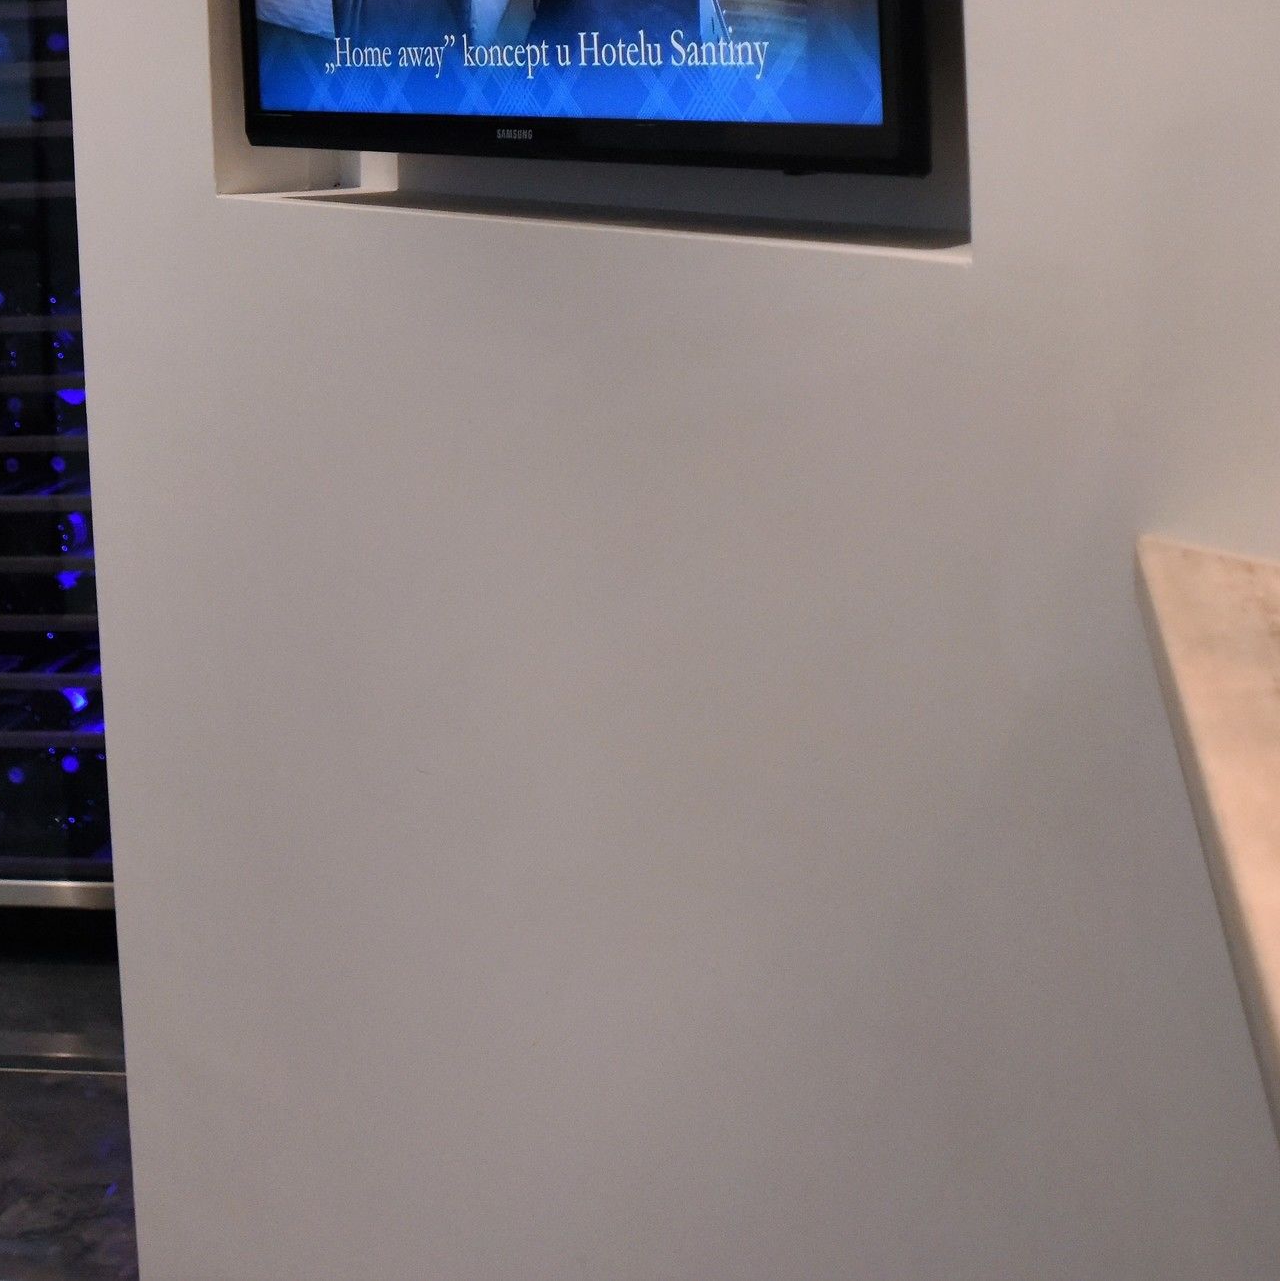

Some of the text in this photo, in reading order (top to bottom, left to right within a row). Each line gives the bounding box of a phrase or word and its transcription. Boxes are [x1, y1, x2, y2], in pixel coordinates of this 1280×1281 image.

[462, 32, 550, 80] koncept
[556, 43, 572, 67] u
[577, 29, 664, 68] Hotelu
[670, 25, 770, 80] Santiny
[496, 128, 533, 140] SAMSUNG
